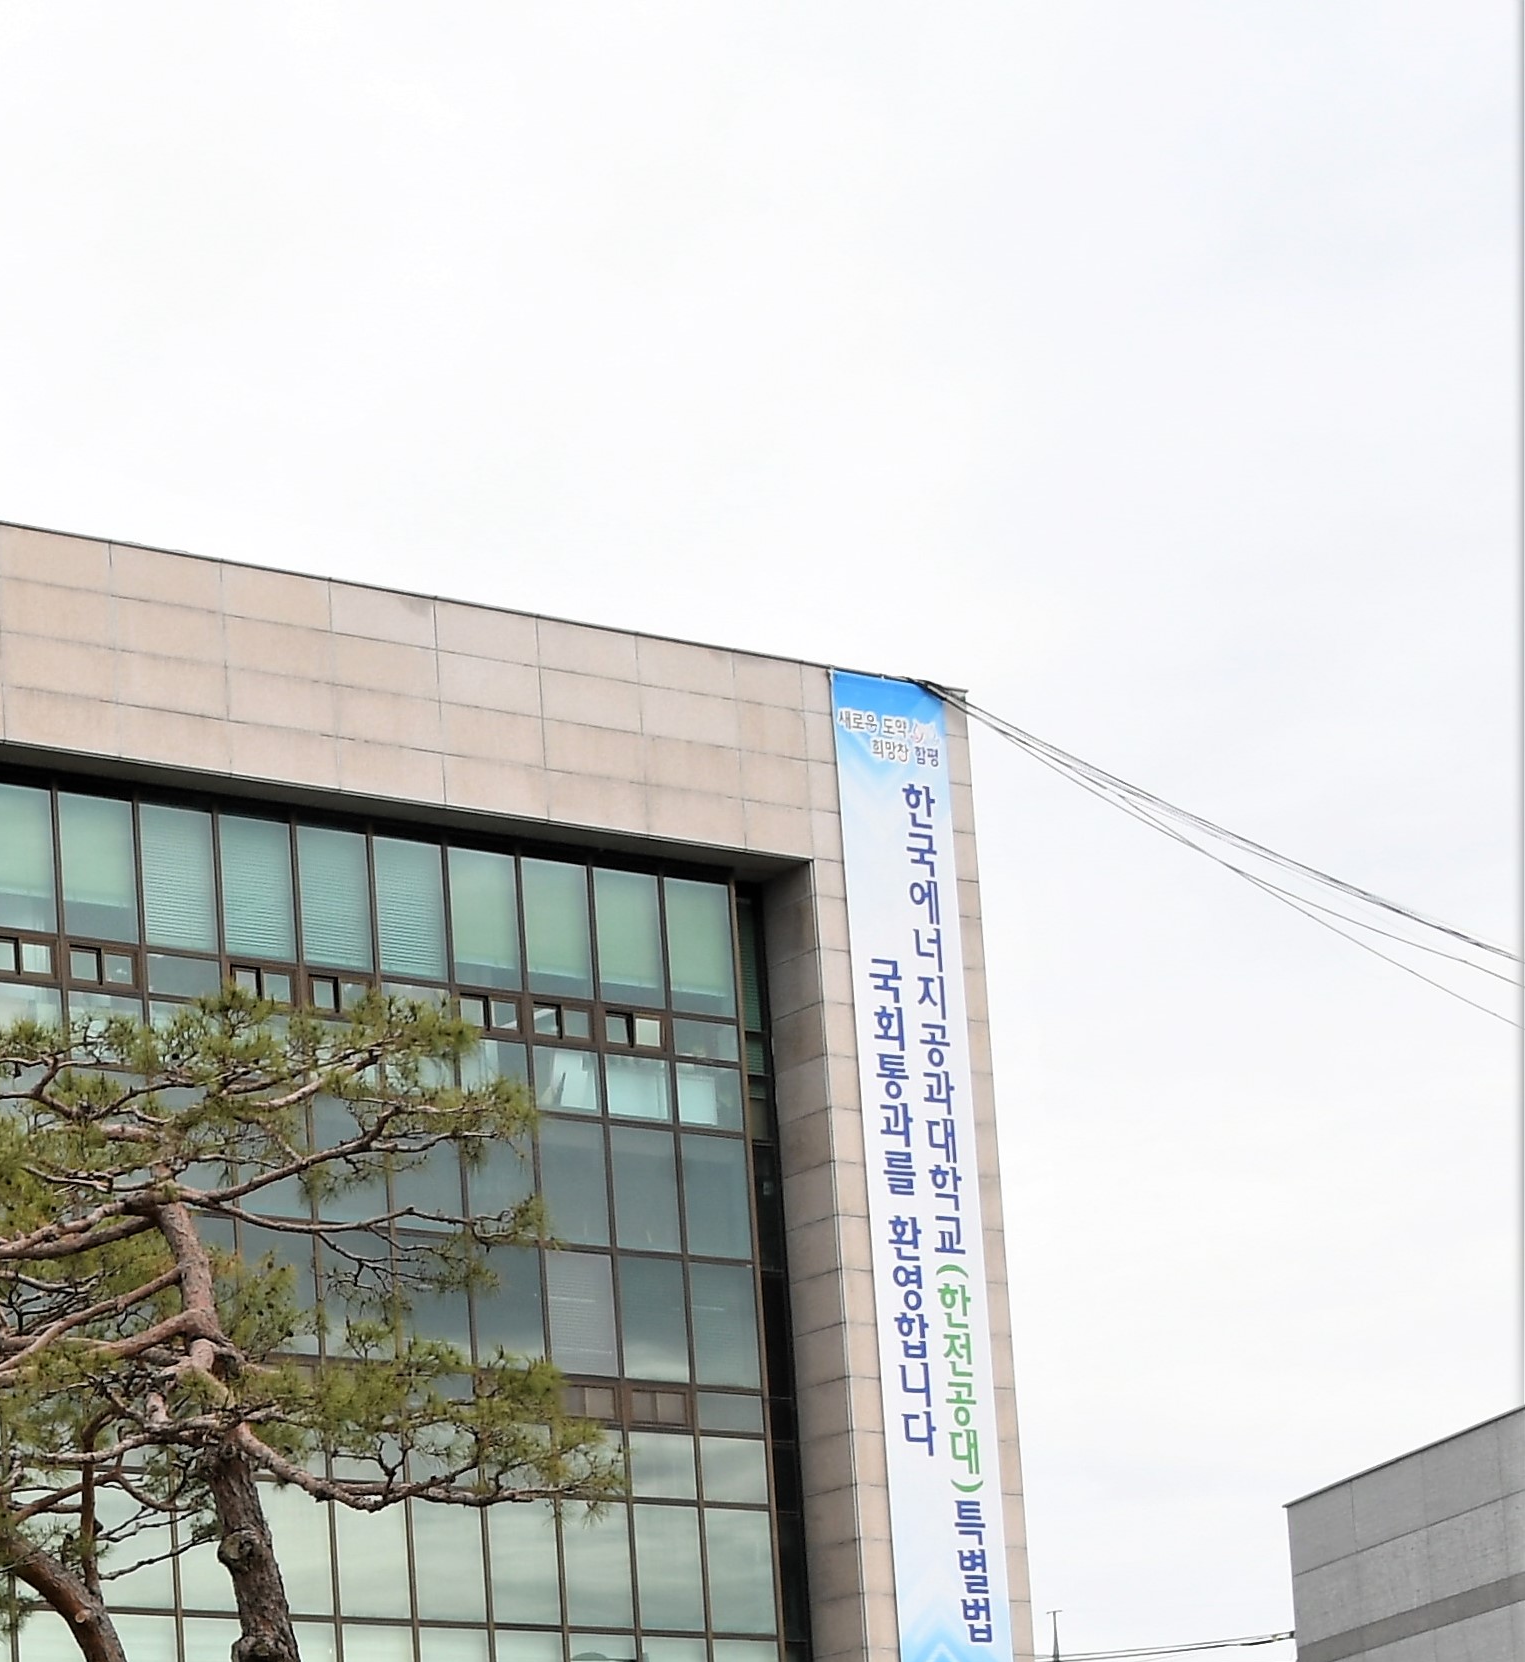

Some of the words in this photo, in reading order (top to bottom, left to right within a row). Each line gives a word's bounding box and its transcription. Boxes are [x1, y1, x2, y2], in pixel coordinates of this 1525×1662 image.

[838, 709, 878, 732] 새로운
[883, 717, 907, 738] 도약
[871, 739, 909, 762] 희망찬
[915, 745, 939, 768] 함평
[869, 958, 917, 1196] 국회통과를
[887, 1215, 936, 1457] 환영합니다
[954, 1499, 994, 1644] 특별법
